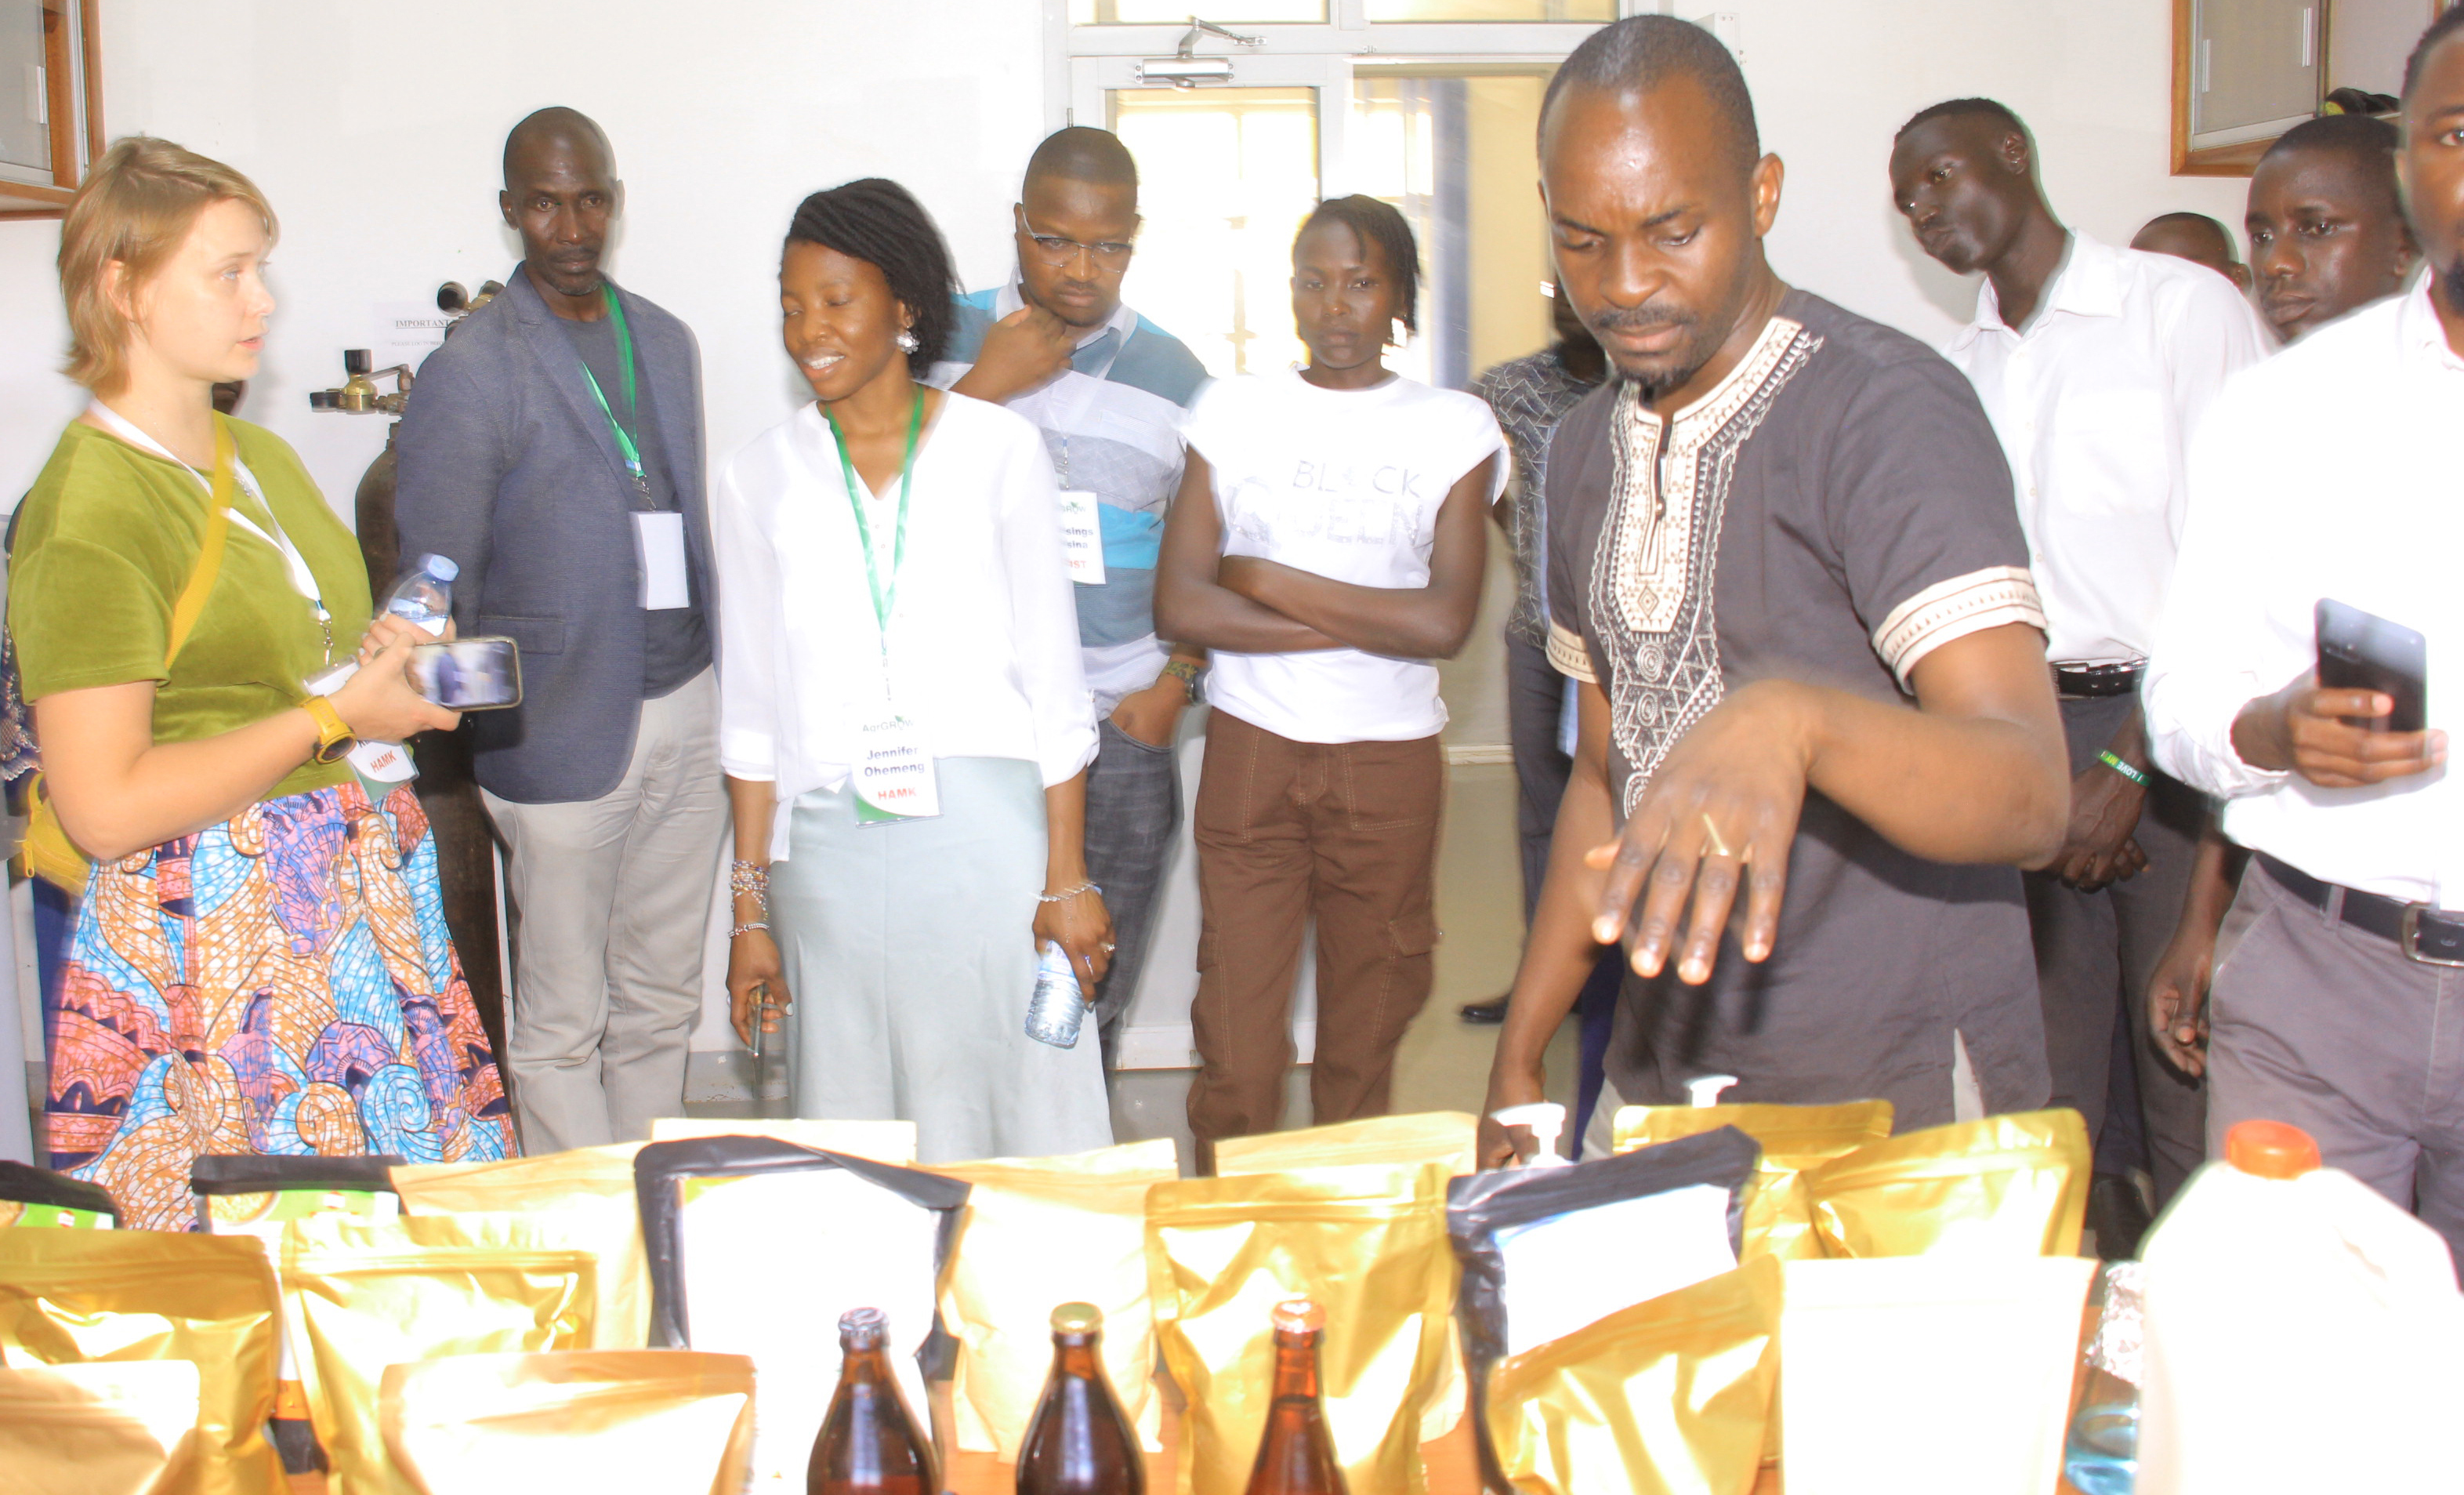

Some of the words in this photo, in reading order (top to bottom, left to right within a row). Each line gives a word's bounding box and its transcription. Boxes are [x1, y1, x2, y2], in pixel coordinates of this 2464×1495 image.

[395, 319, 451, 328] IMPORTANT
[866, 746, 919, 760] Jennifer
[370, 750, 397, 773] HAMK
[864, 763, 926, 777] Ohemeng
[2115, 760, 2139, 779] LOVE
[877, 786, 917, 801] HAMK
